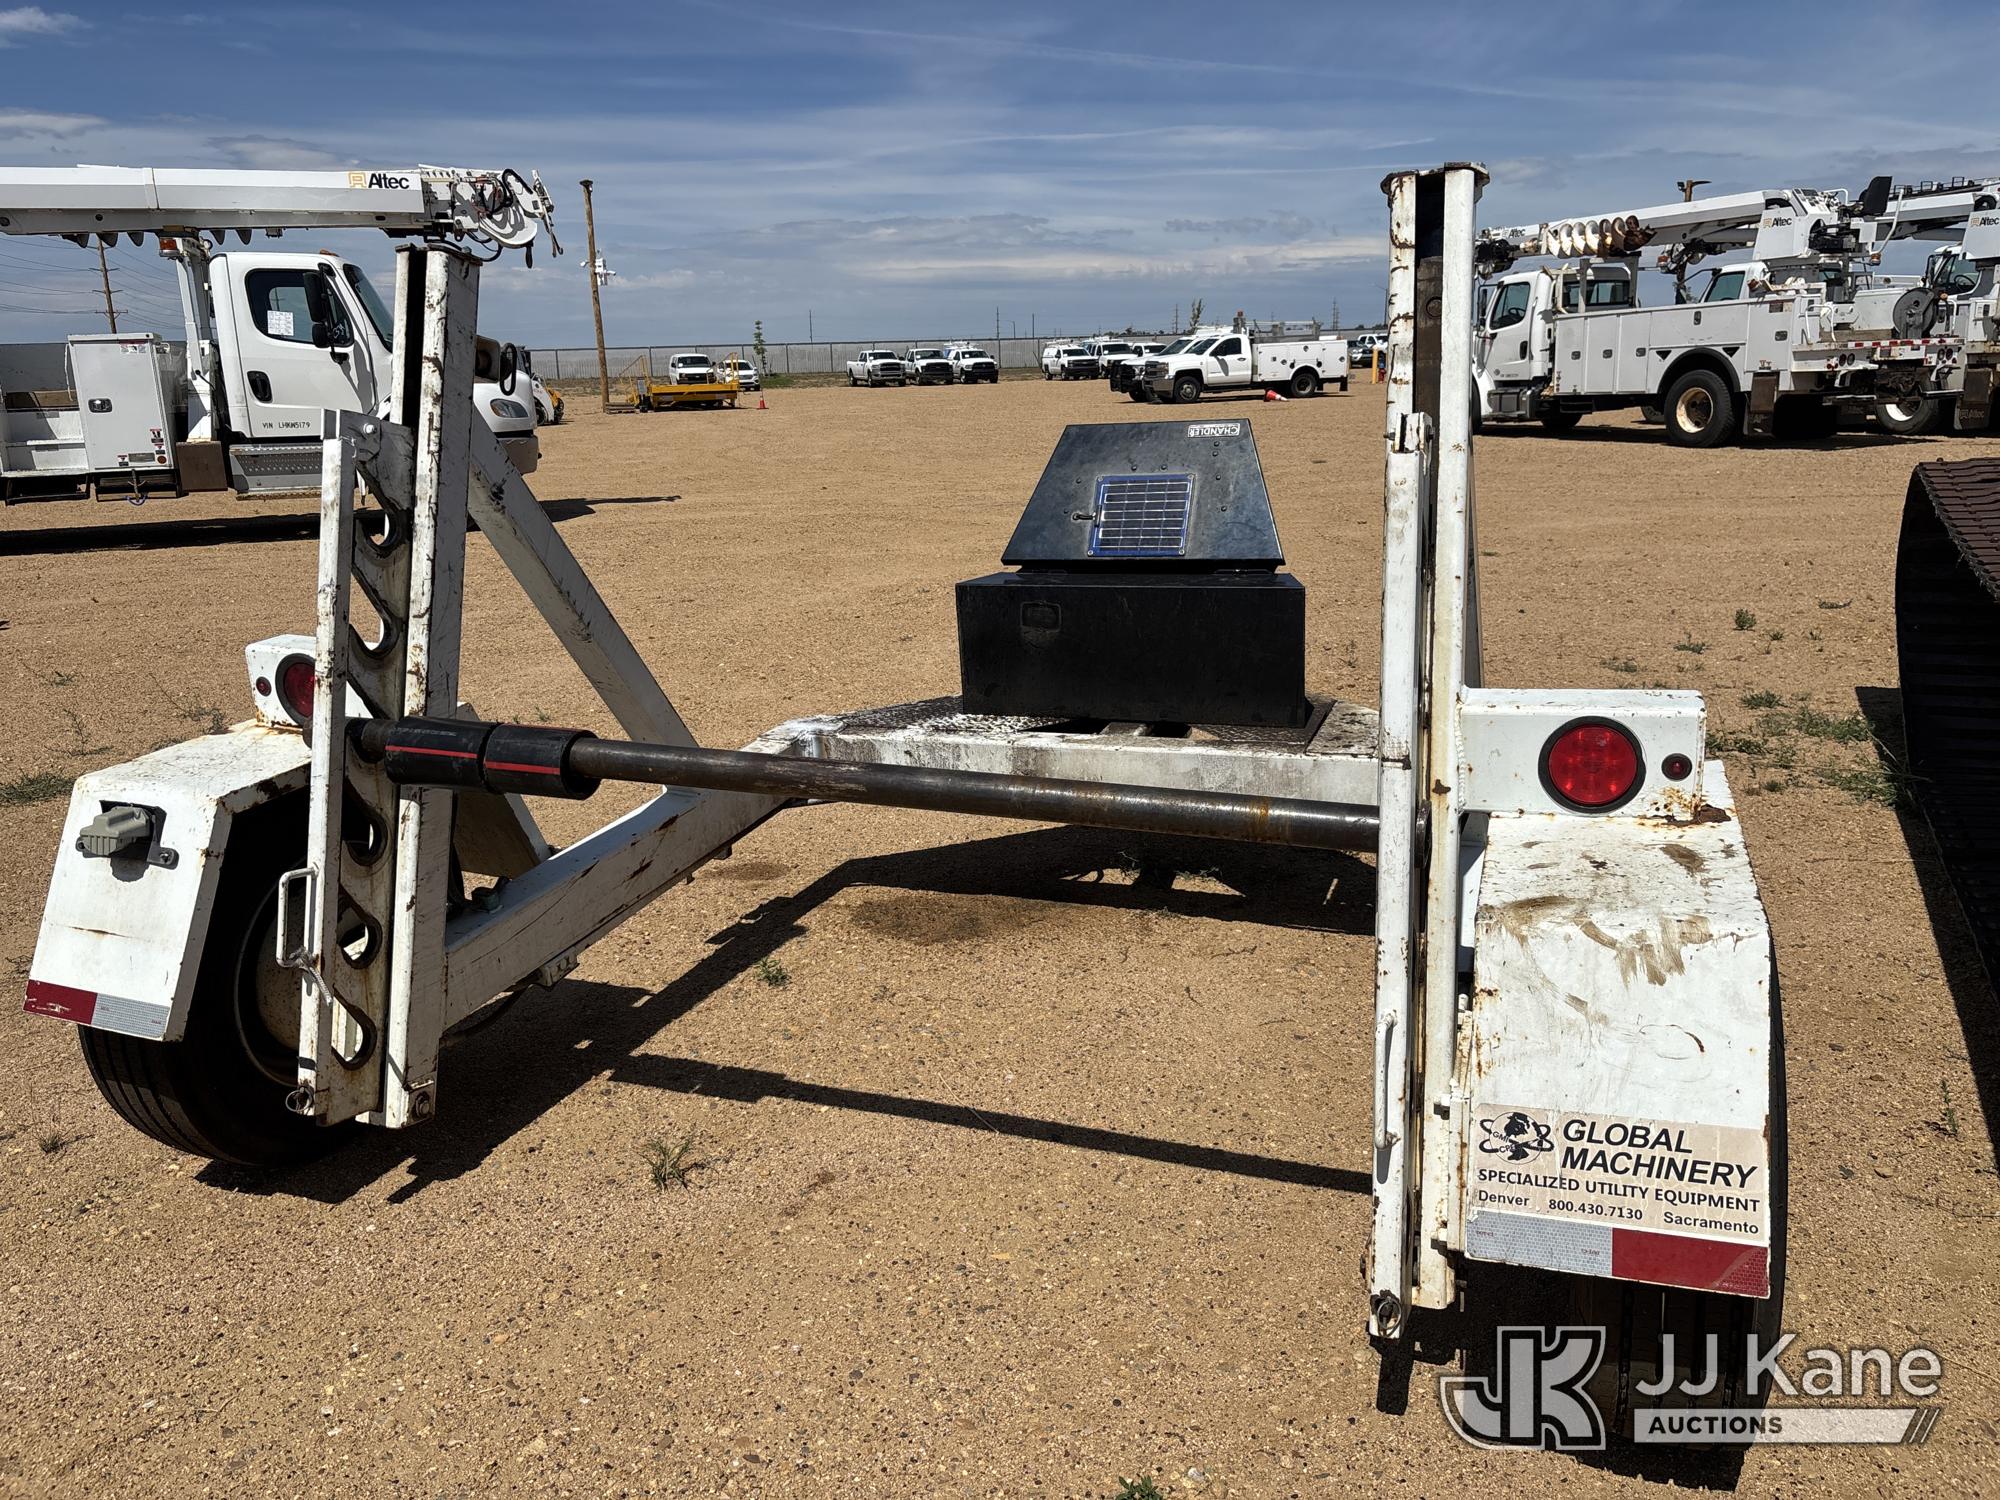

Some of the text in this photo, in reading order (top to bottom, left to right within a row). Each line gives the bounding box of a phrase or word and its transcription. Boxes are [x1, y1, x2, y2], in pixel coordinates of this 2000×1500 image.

[368, 173, 410, 189] Altec
[1772, 217, 1792, 227] Altec
[1980, 217, 2000, 226] Altec
[1509, 228, 1526, 238] Altec
[1189, 426, 1239, 437] CHANDLER
[1563, 1119, 1693, 1154] GLOBAL
[1561, 1146, 1758, 1189] MACHINERY
[1478, 1168, 1760, 1212] SPECIALIZED UTILITY EQUIPMENT
[1478, 1190, 1759, 1234] Denver 800.430.7130 Sacramento
